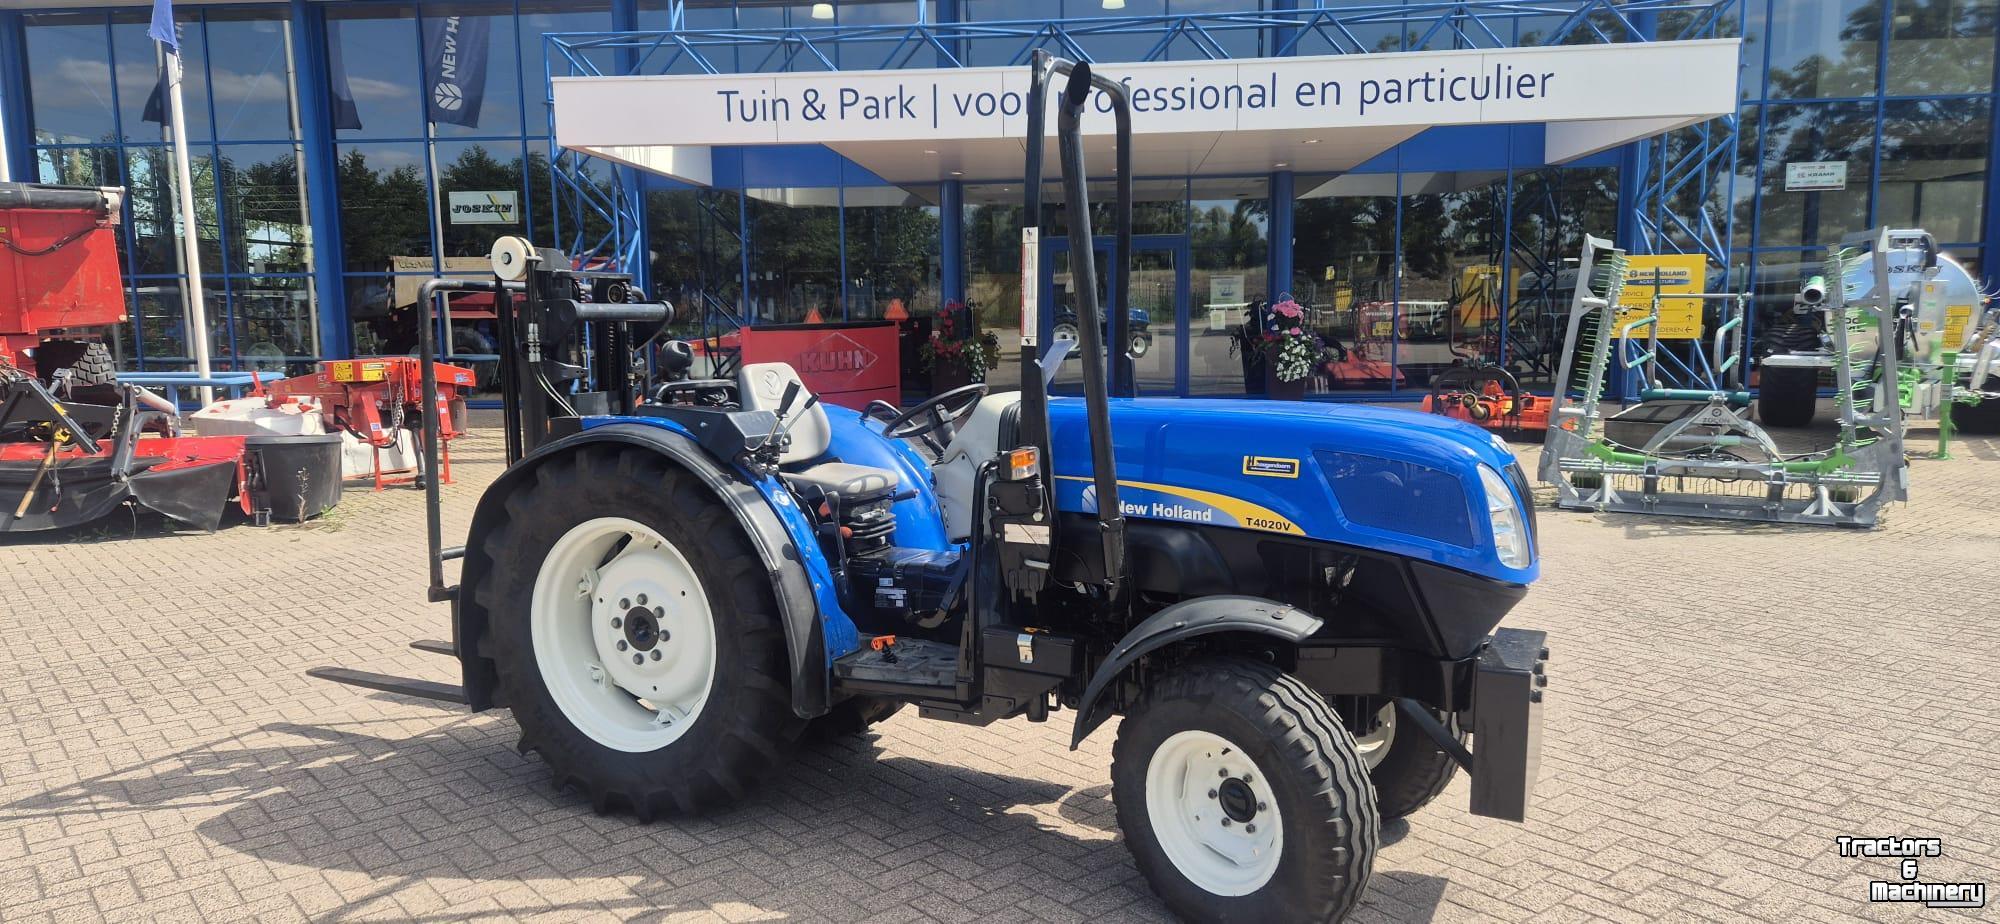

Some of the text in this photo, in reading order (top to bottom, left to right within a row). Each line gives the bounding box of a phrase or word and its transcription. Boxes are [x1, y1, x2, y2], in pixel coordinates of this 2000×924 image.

[442, 35, 457, 79] NEW
[717, 89, 790, 122] Tuin
[801, 88, 826, 121] &
[839, 84, 917, 120] Park
[1058, 72, 1277, 113] oessional
[1295, 80, 1341, 107] en
[1360, 63, 1555, 115] particulier
[452, 204, 513, 214] JOSKIN
[801, 350, 864, 371] KUHN
[1152, 502, 1212, 522] Holland
[1246, 517, 1291, 531] T4020V
